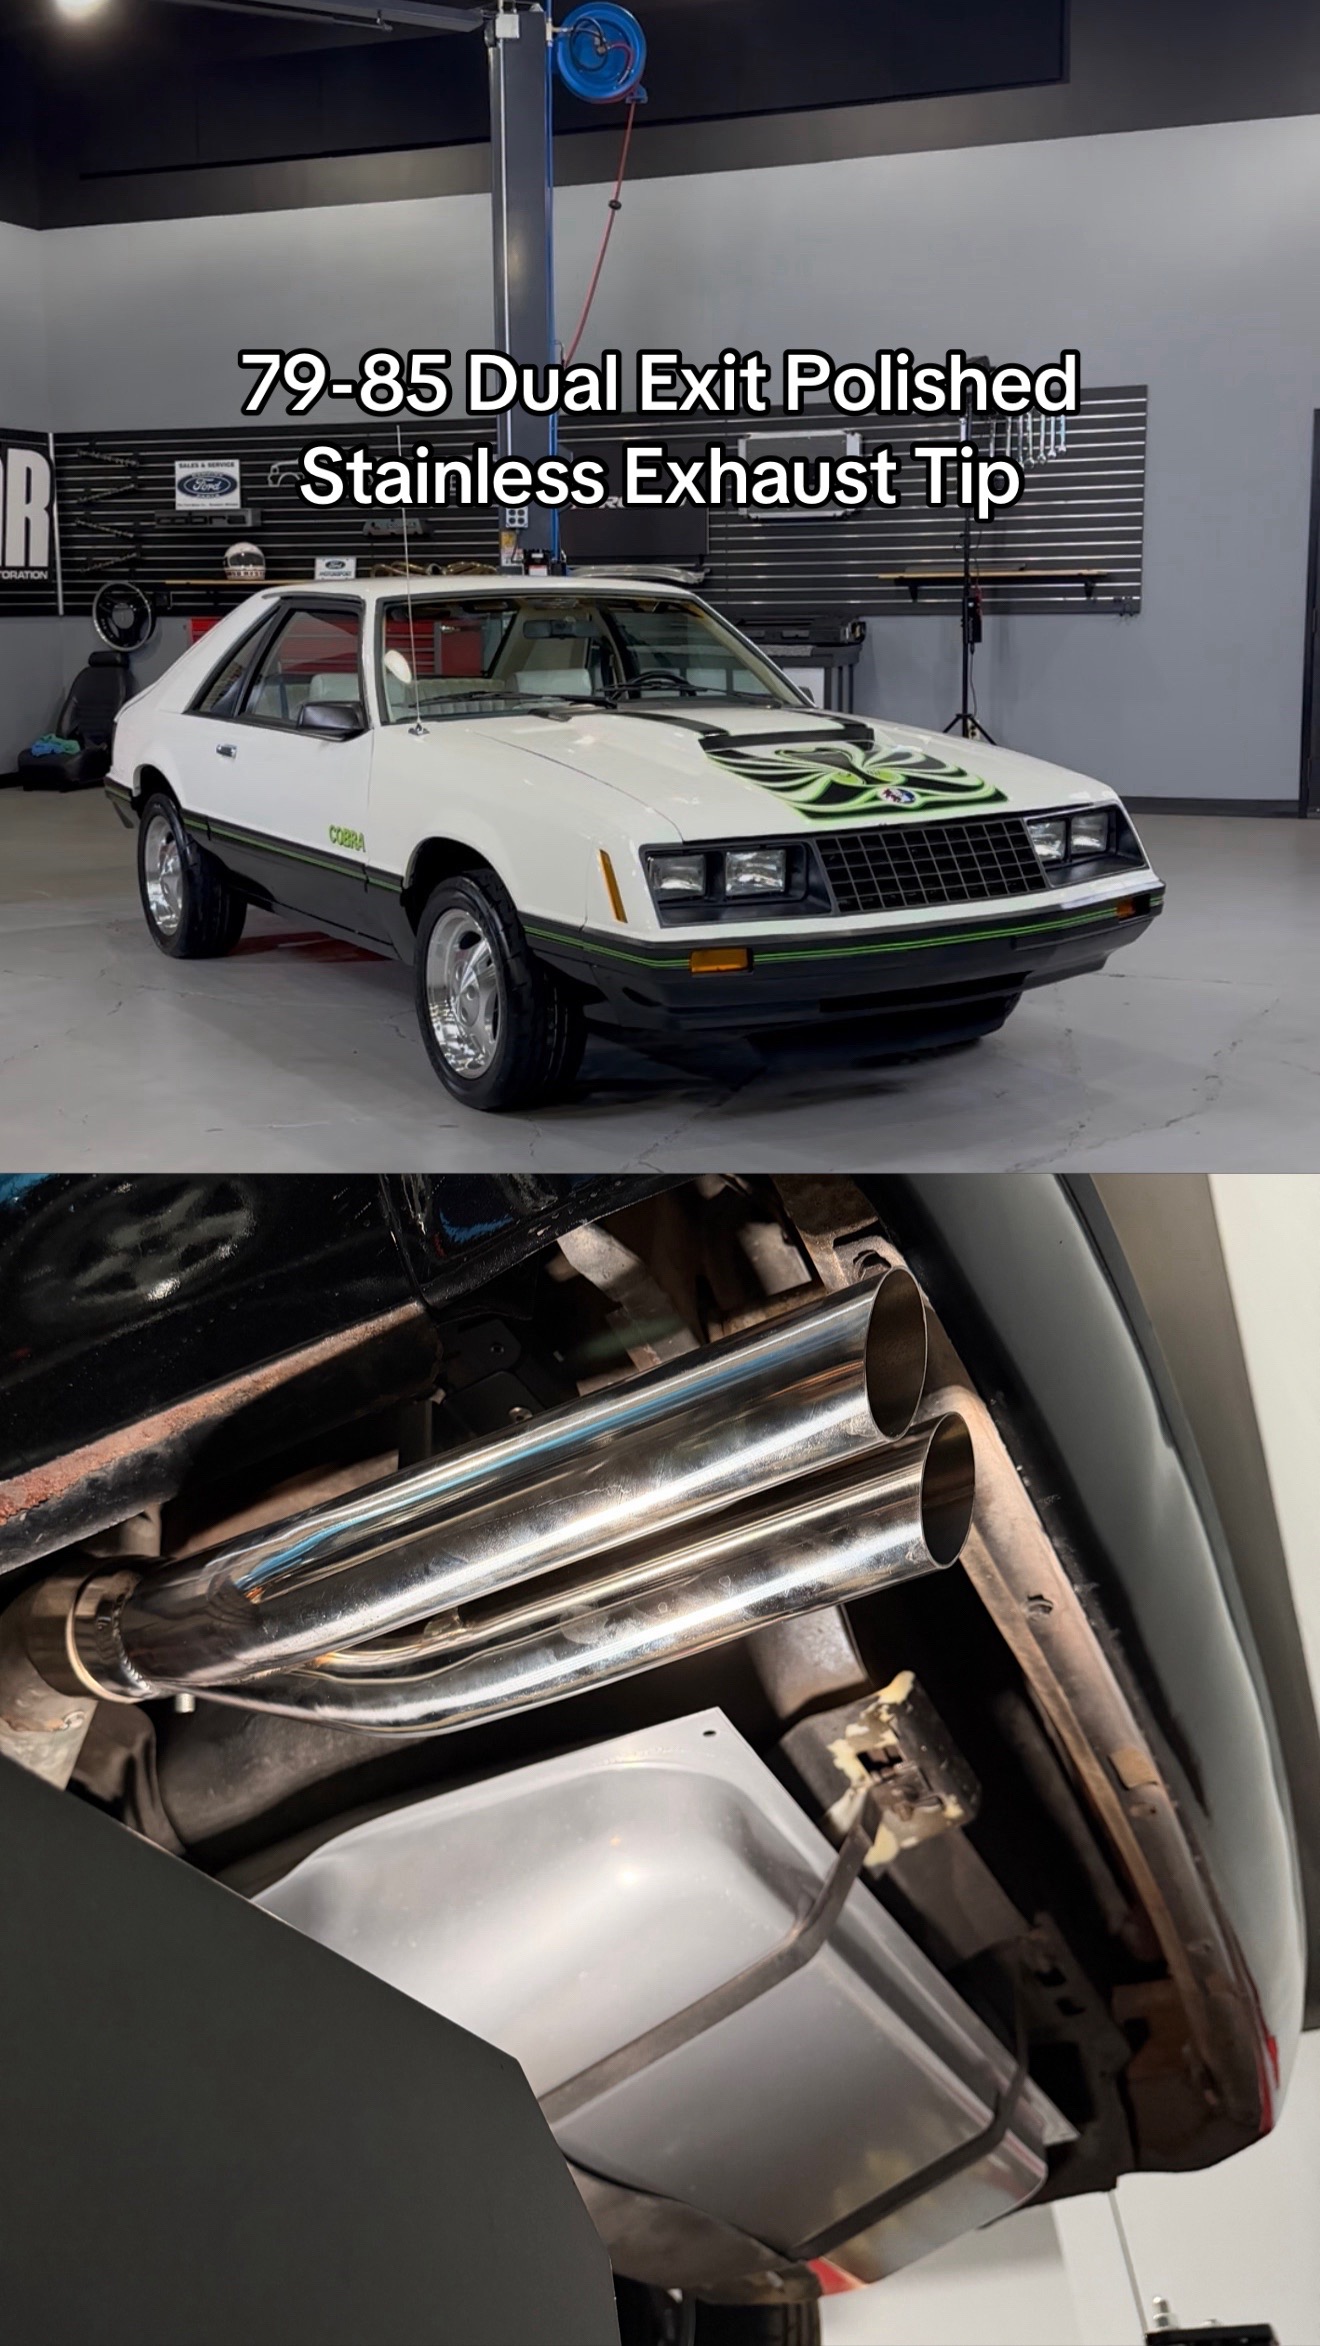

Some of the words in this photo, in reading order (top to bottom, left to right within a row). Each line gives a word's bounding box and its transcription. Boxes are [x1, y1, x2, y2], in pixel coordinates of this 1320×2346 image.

[192, 477, 222, 491] Ford
[0, 447, 51, 568] R
[328, 823, 367, 853] COBRA
